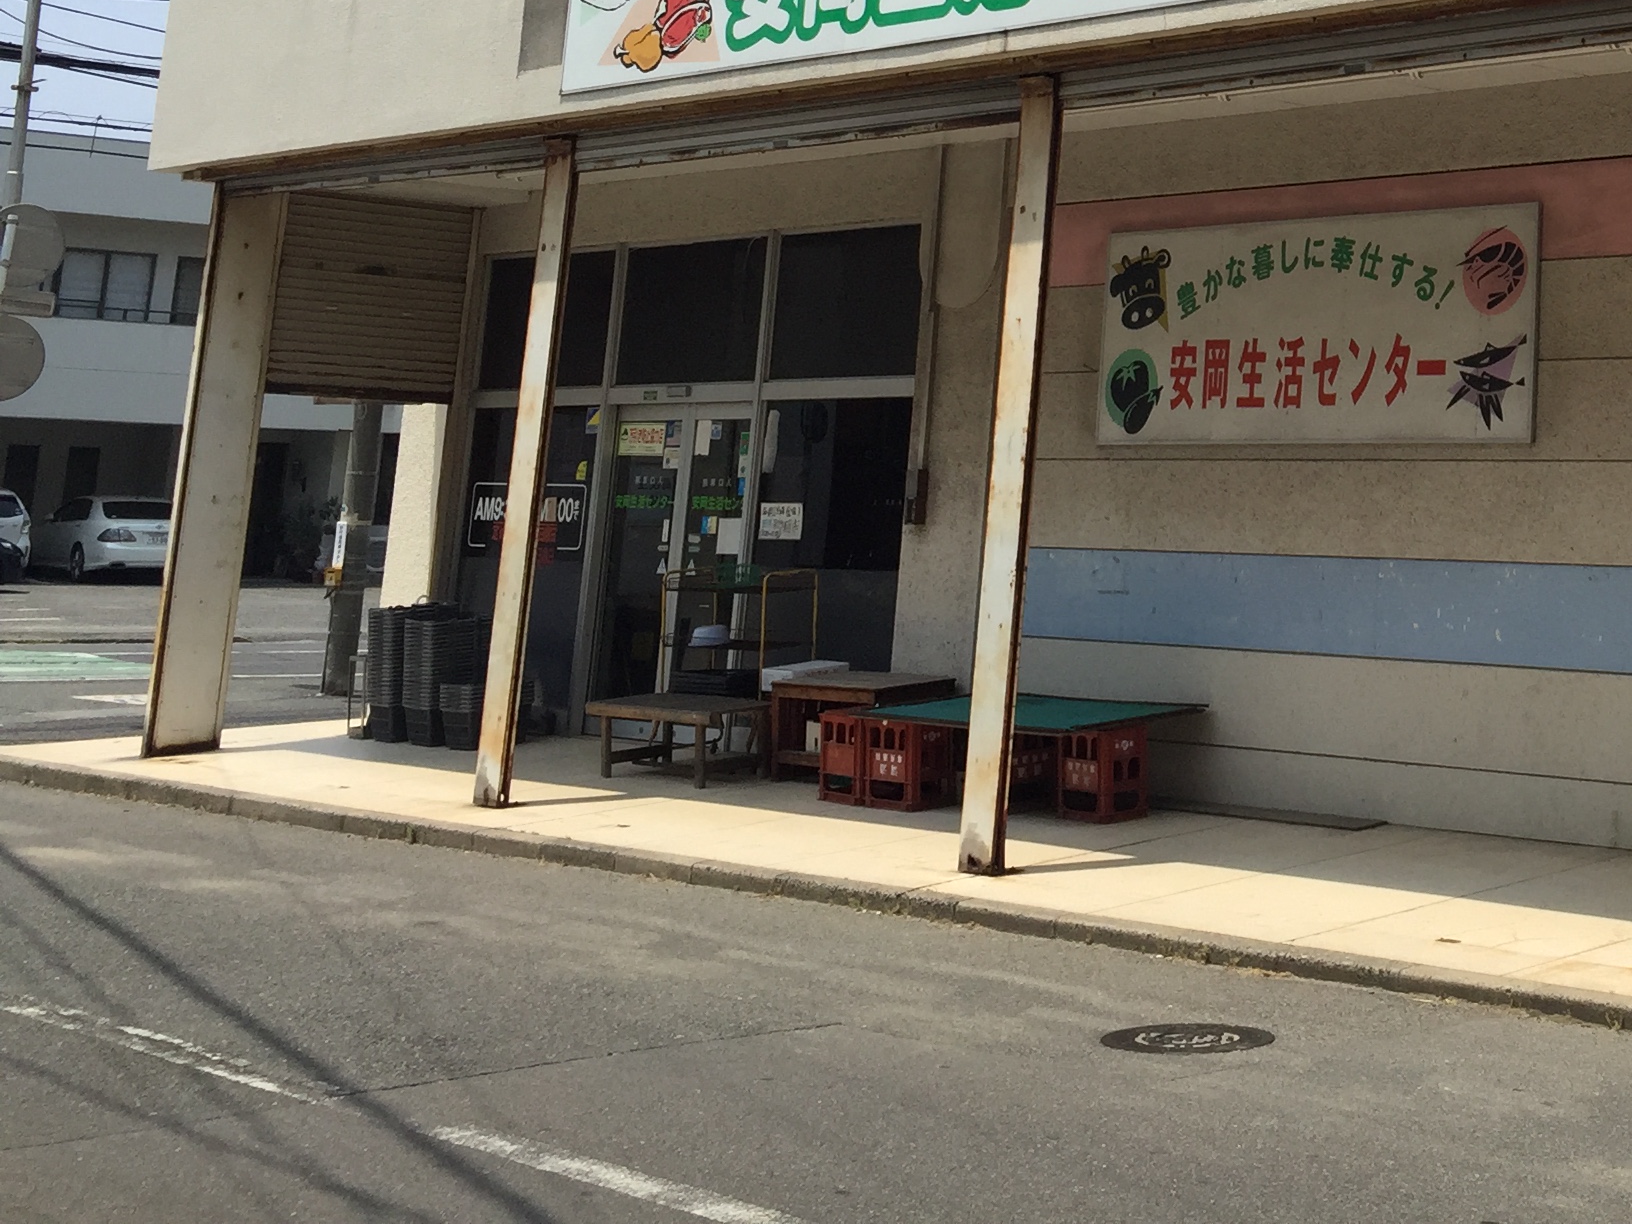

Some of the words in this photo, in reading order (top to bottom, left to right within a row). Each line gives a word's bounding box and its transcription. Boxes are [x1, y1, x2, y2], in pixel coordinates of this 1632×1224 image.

[1169, 333, 1447, 410] 安岡生活センター
[692, 495, 743, 511] 安岡生活セン
